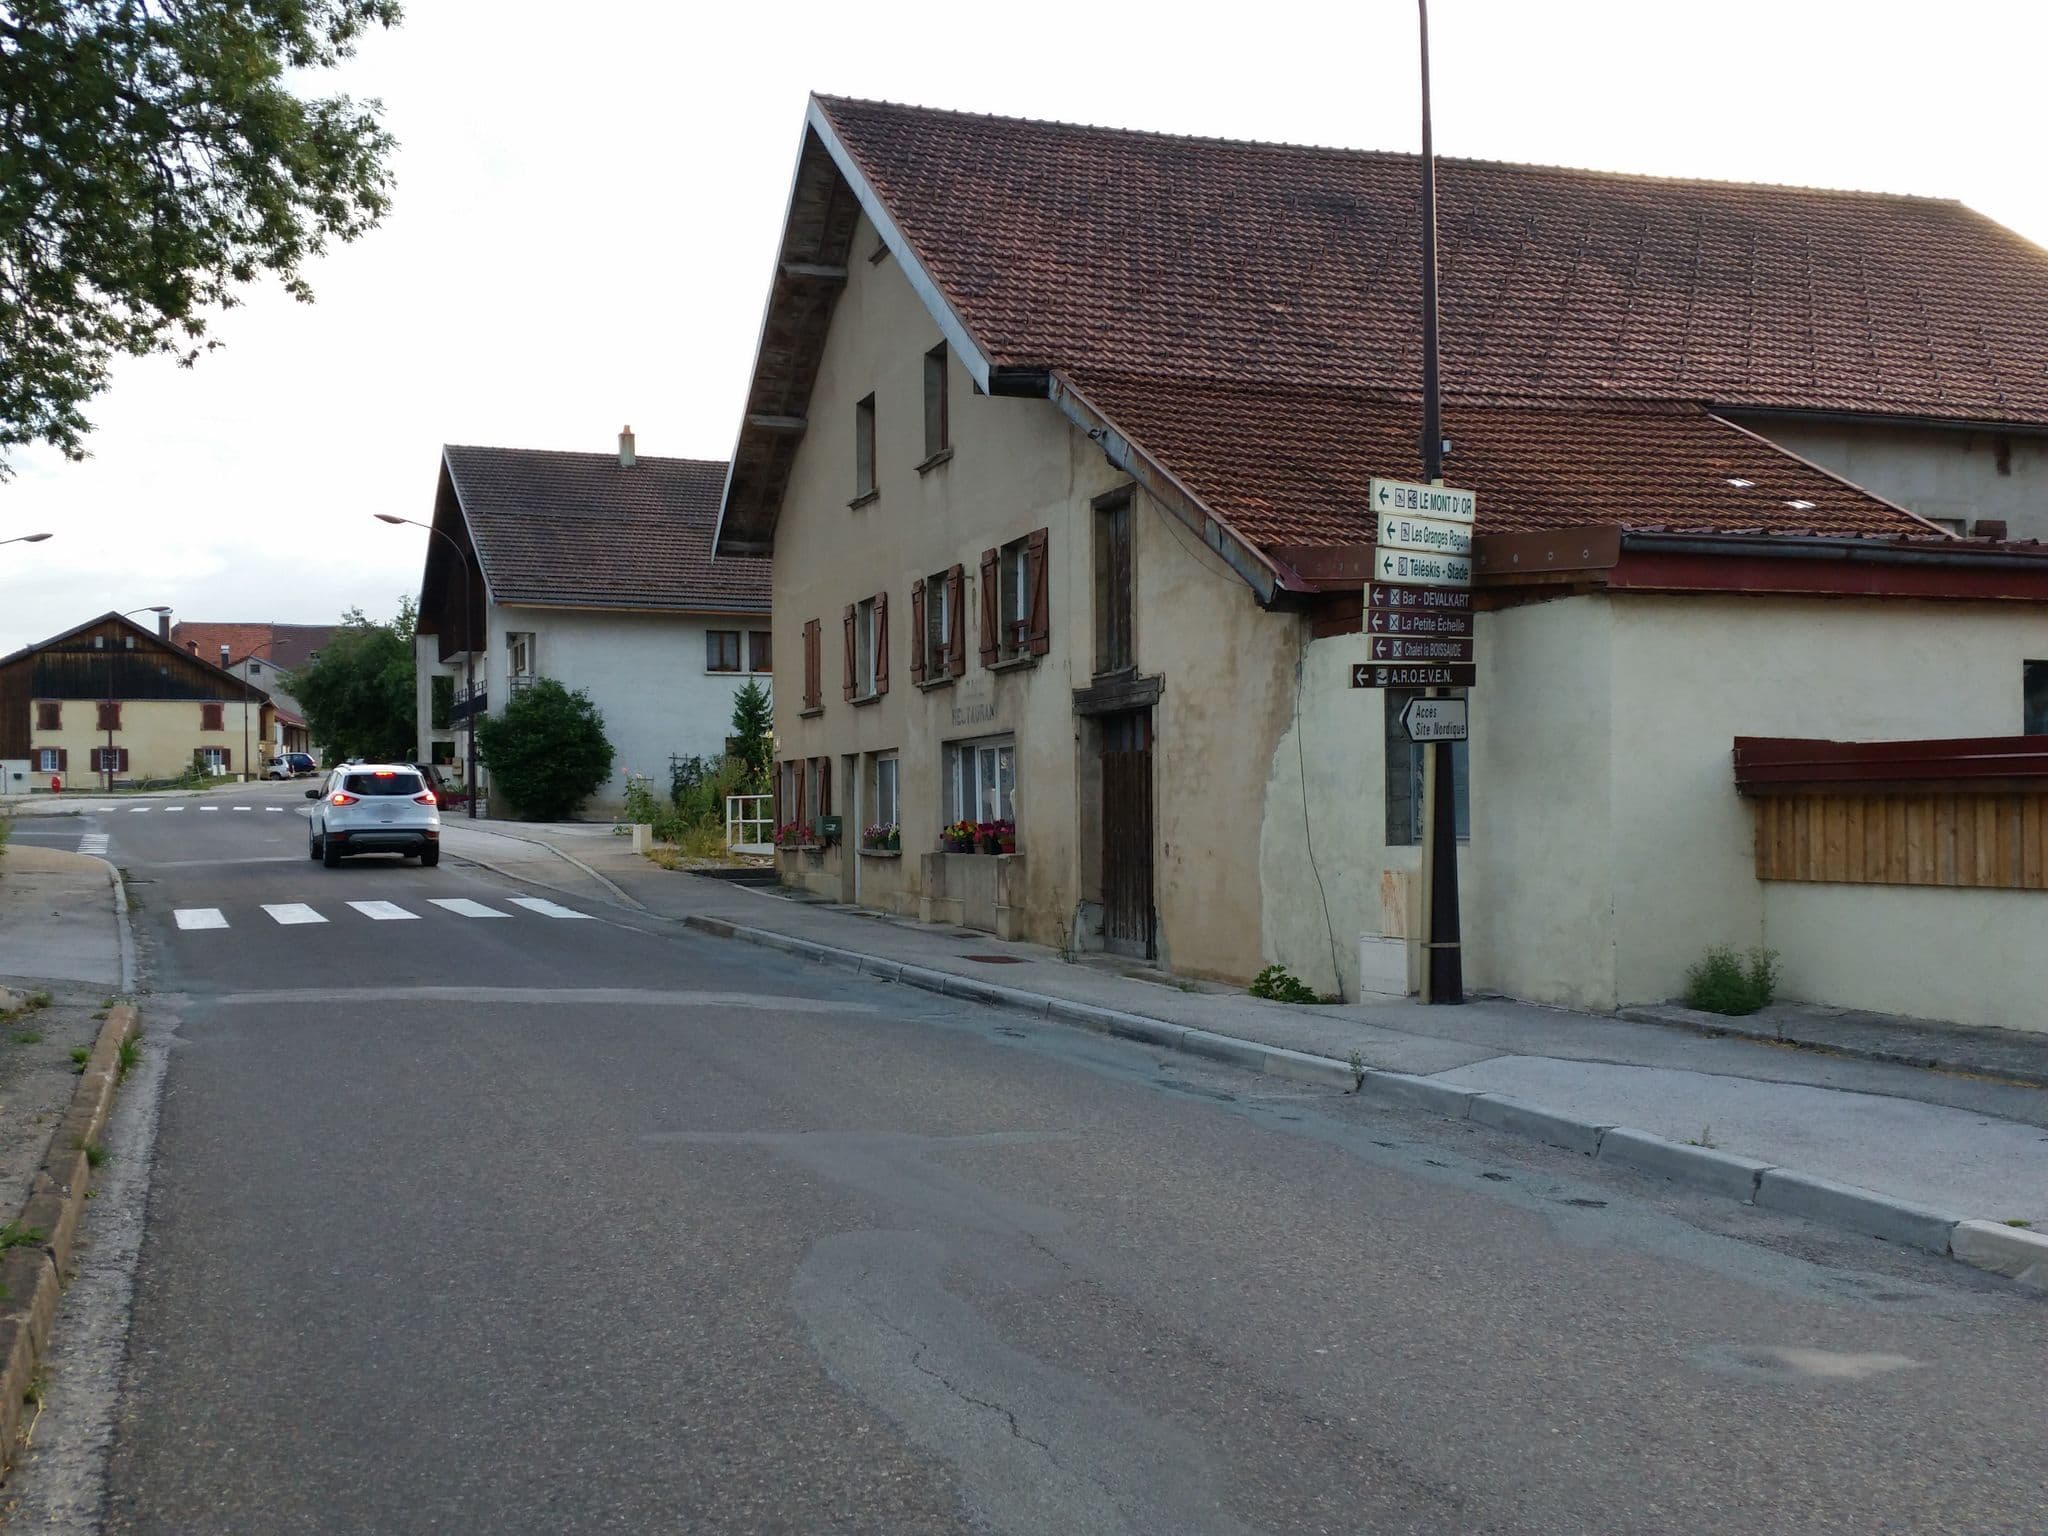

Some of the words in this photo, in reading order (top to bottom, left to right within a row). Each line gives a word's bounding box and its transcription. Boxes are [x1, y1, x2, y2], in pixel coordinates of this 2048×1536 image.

[1420, 492, 1428, 510] LE
[1430, 494, 1452, 513] MONT
[1411, 525, 1422, 542] Les
[1424, 526, 1448, 549] Granges
[1410, 559, 1440, 578] Téléskis
[1447, 562, 1469, 580] Stade
[1402, 591, 1417, 605] Bar
[1423, 592, 1470, 607] DEVALKART
[1401, 617, 1412, 630] La
[1413, 617, 1436, 631] Petite
[1437, 615, 1465, 632] Échelle
[1404, 642, 1423, 657] Chalet
[1416, 704, 1437, 719] Accès
[1416, 722, 1430, 736] Site
[1433, 721, 1465, 739] Nordique
